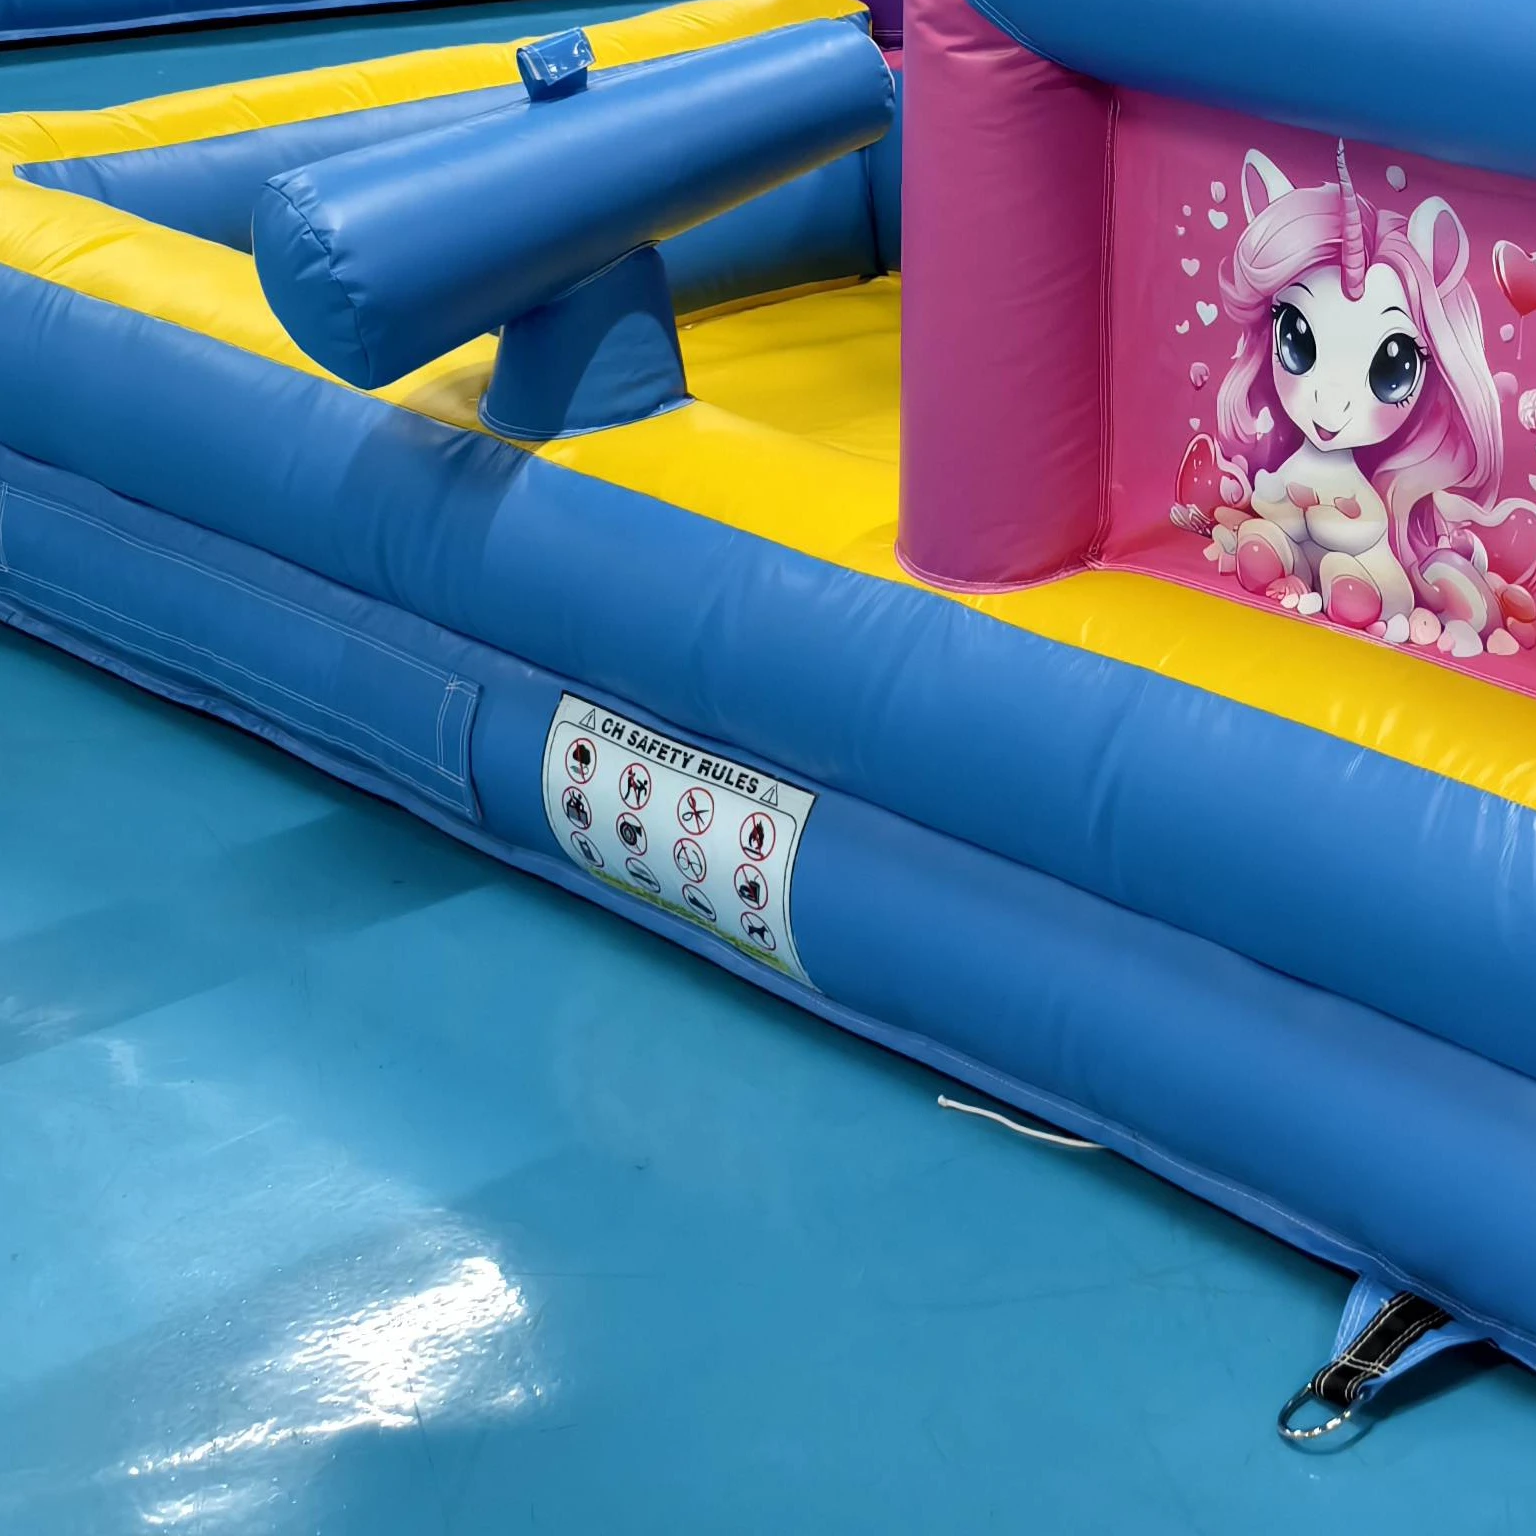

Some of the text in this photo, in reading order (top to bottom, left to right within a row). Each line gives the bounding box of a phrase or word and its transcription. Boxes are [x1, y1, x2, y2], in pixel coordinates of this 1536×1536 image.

[601, 718, 759, 794] CH SAFETY RULES
